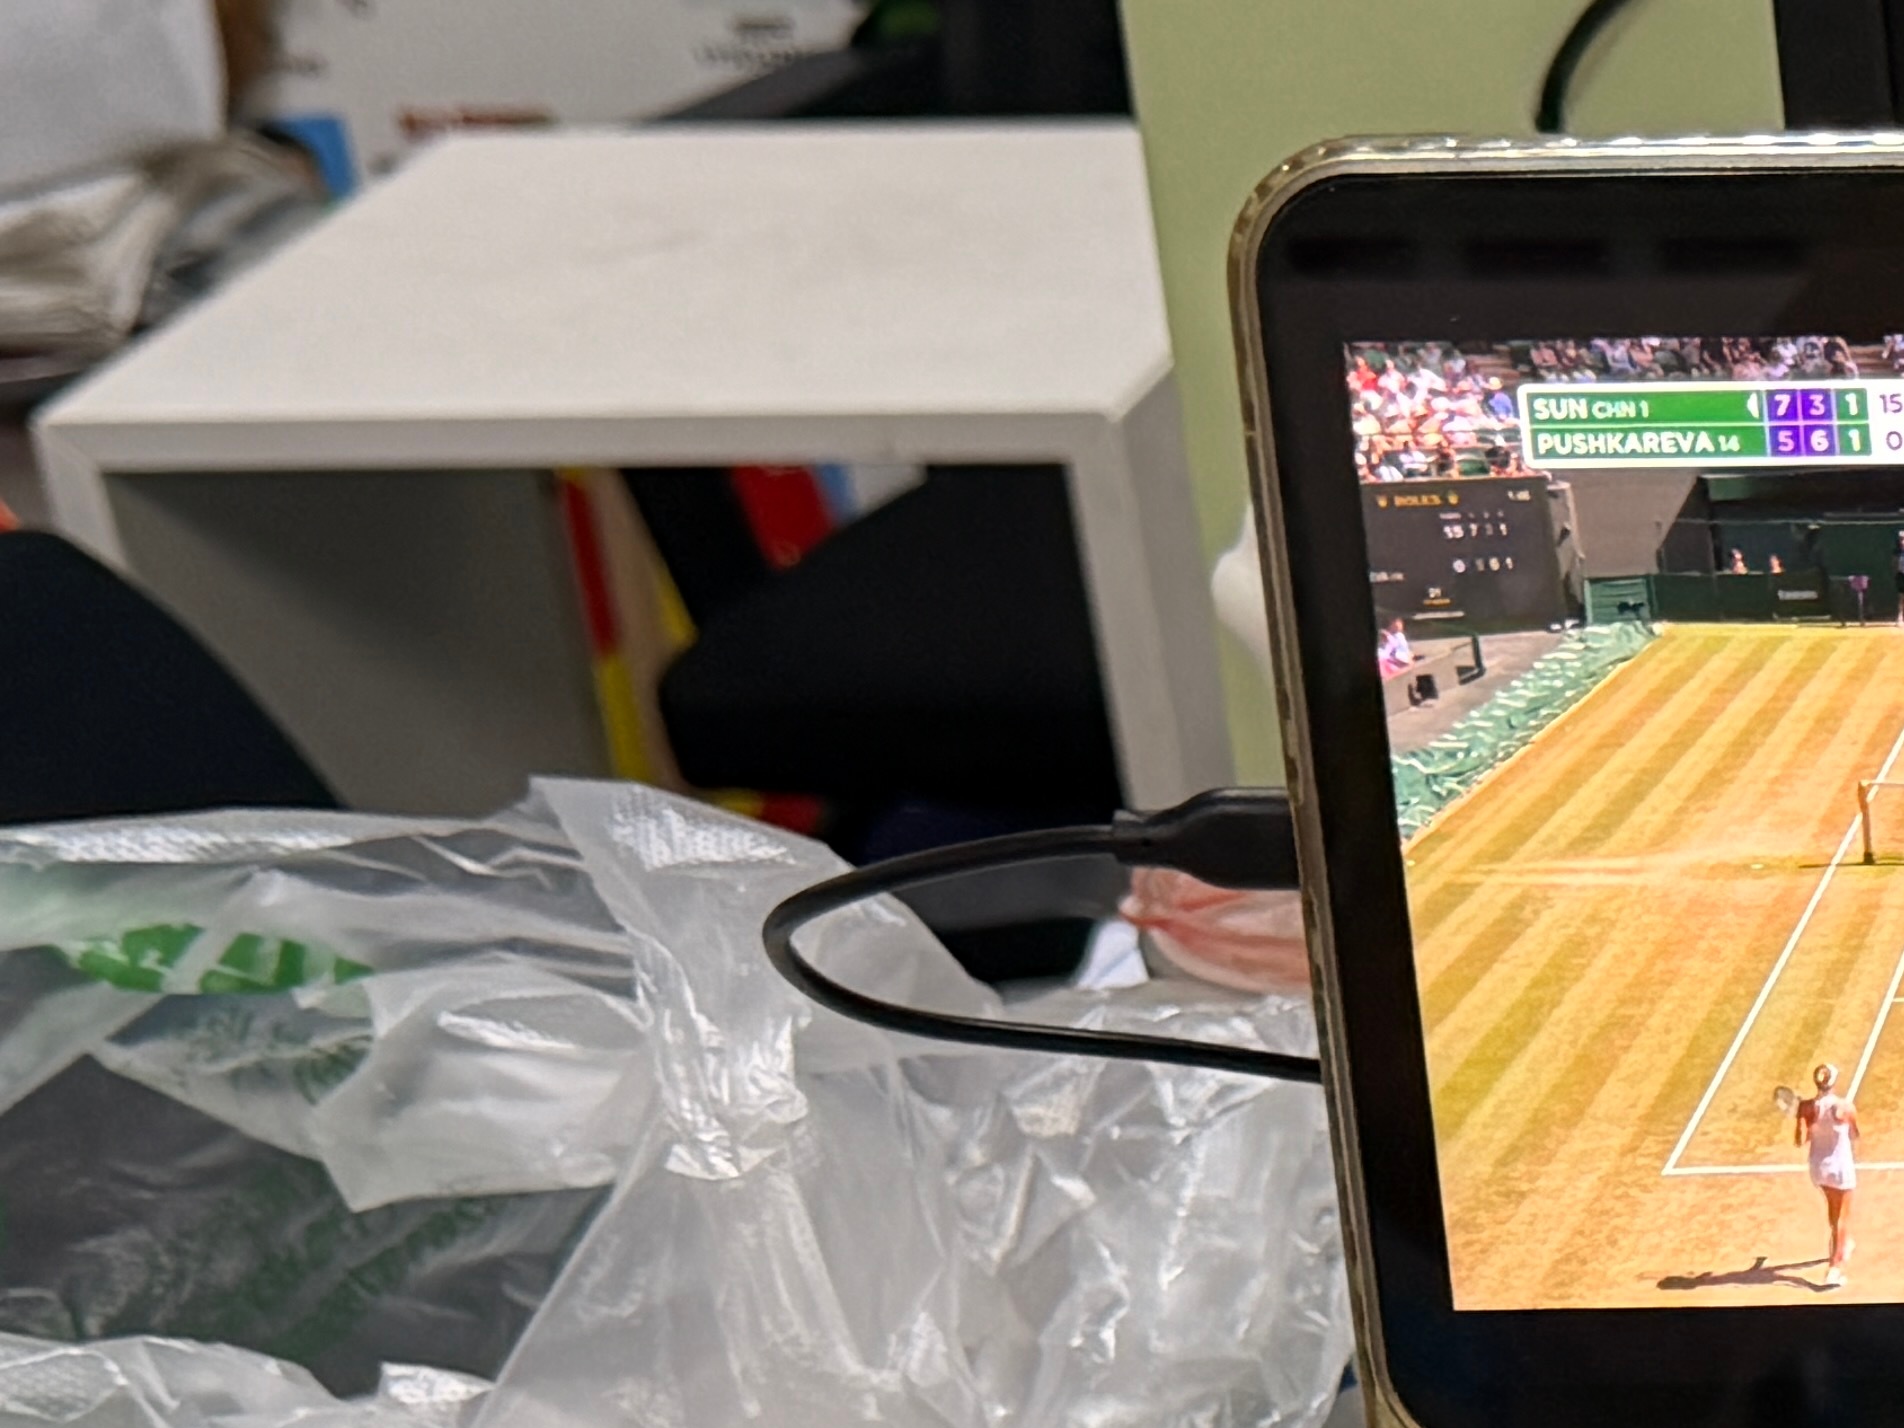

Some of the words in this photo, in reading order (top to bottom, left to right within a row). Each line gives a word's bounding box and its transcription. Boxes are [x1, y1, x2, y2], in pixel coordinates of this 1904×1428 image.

[1533, 397, 1588, 420] SUN
[1592, 400, 1636, 419] CHN
[1639, 400, 1649, 418] 1
[1774, 396, 1790, 417] 7
[1808, 395, 1826, 417] 3
[1845, 394, 1859, 417] 1
[1880, 392, 1903, 414] 15
[1537, 432, 1715, 455] PUSHKAREVA
[1777, 431, 1795, 451] 5
[1810, 430, 1829, 451] 6
[1848, 429, 1862, 451] 1
[1885, 430, 1904, 451] 0
